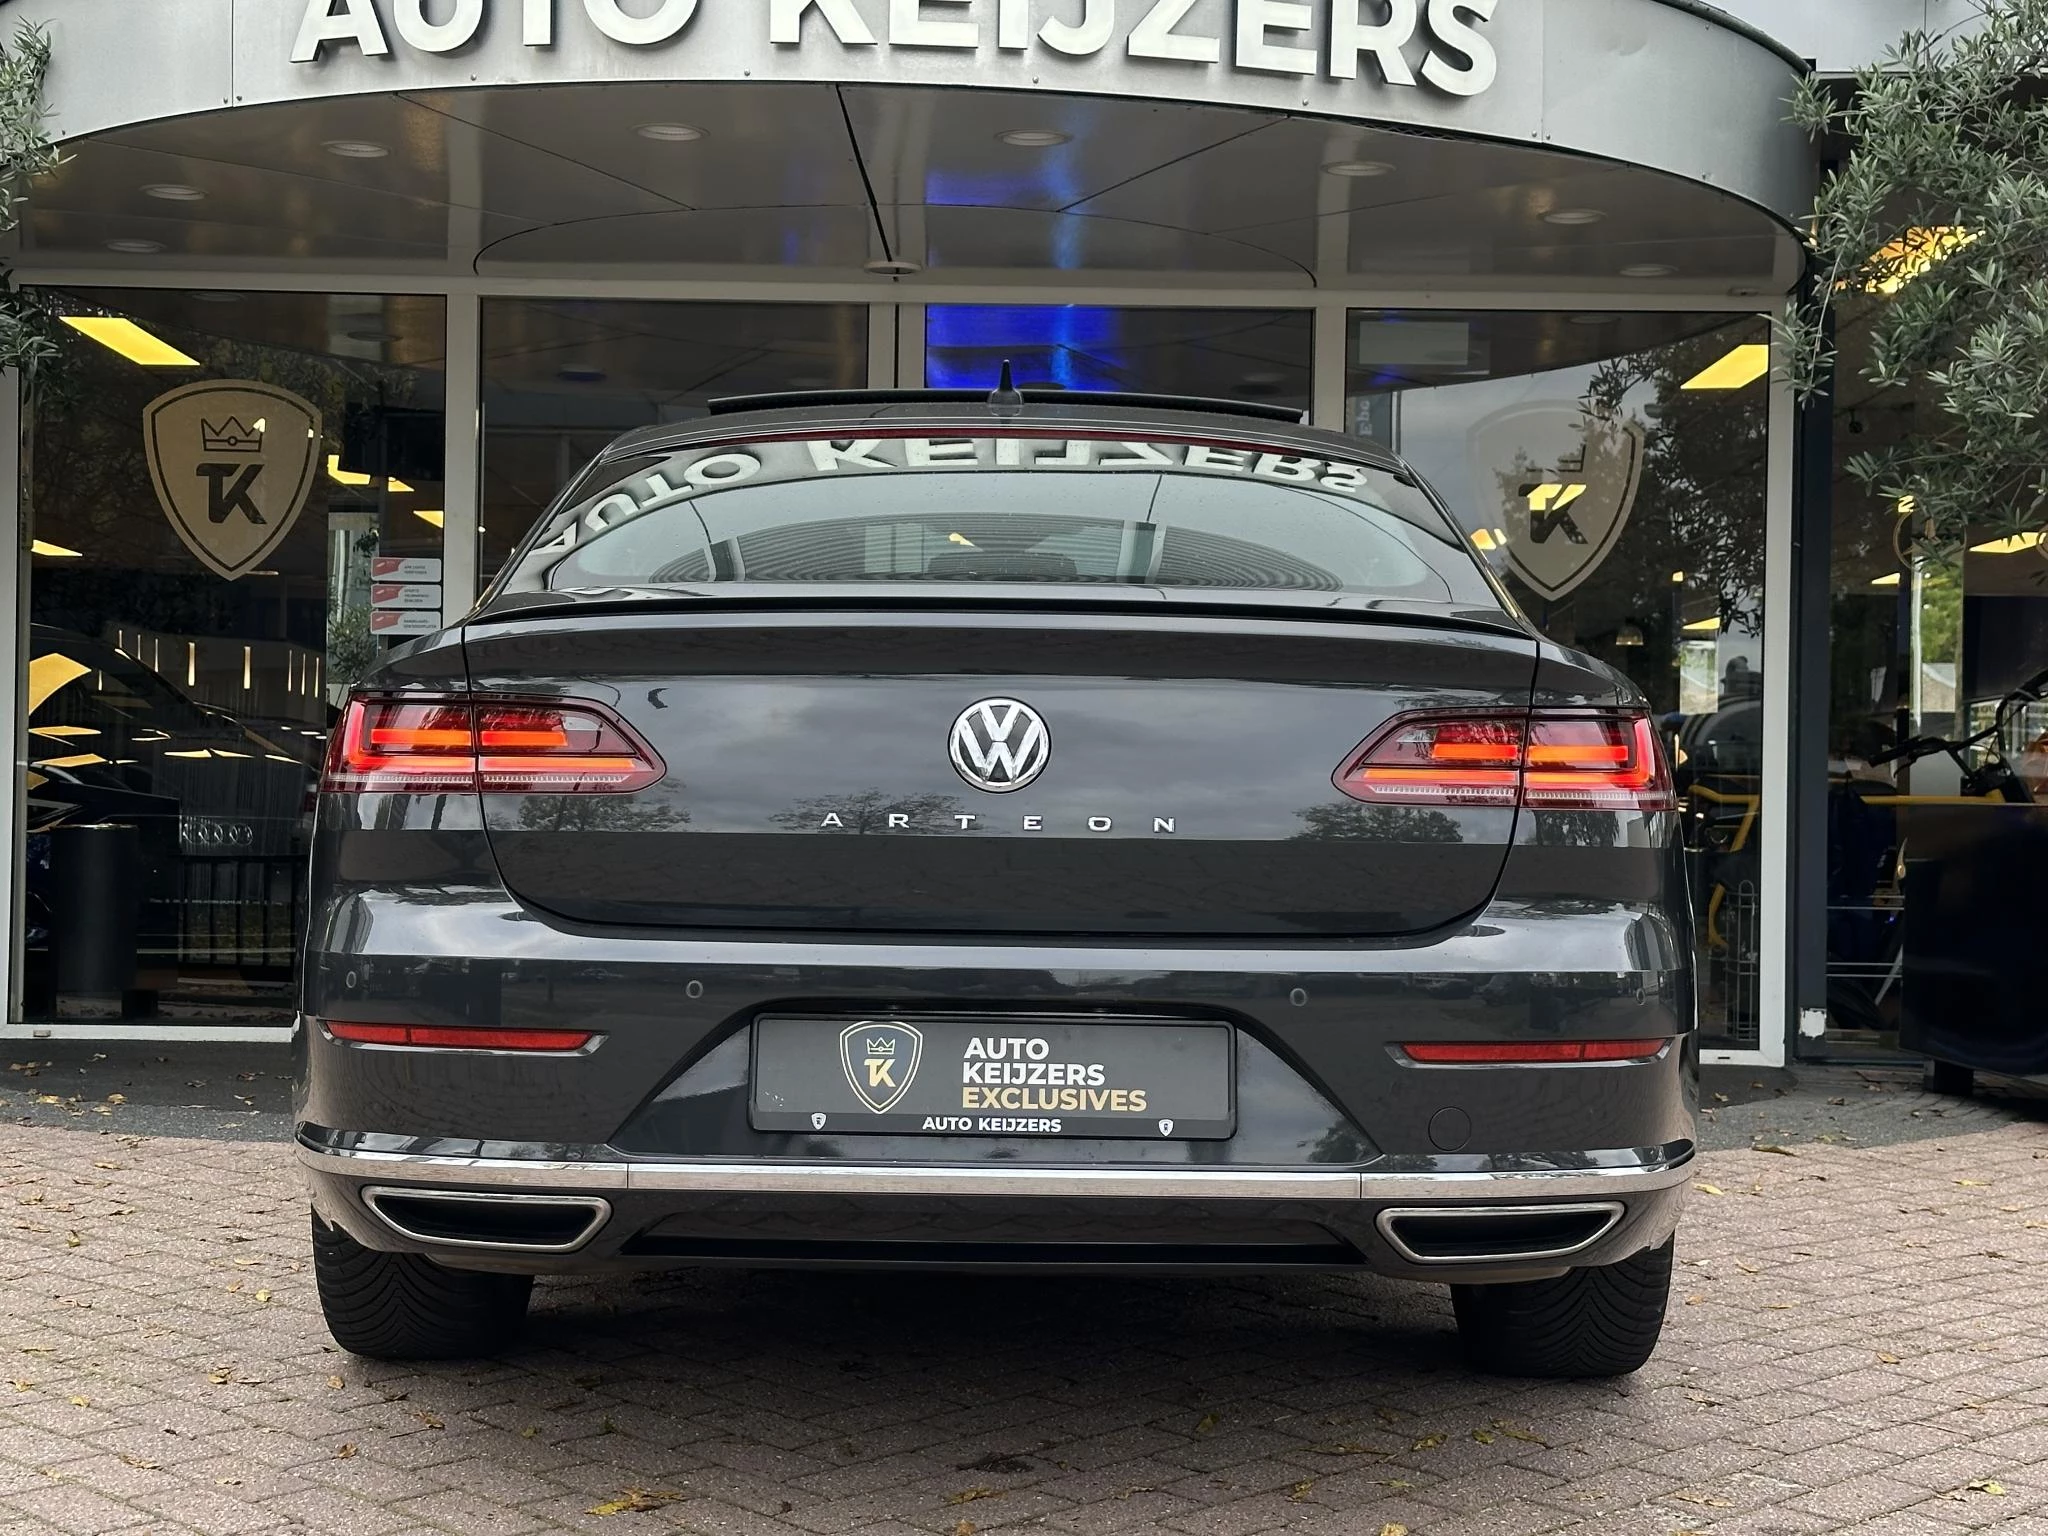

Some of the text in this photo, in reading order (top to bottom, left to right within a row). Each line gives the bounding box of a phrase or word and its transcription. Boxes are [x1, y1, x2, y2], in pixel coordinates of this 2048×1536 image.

[951, 699, 1048, 790] VW
[820, 811, 1176, 833] ARTEON
[963, 1037, 1049, 1060] AUTO
[962, 1062, 1106, 1086] KEIJZERS
[962, 1087, 1147, 1112] EXCLUSIVES
[922, 1117, 1062, 1133] AUTO KEIJZERS
